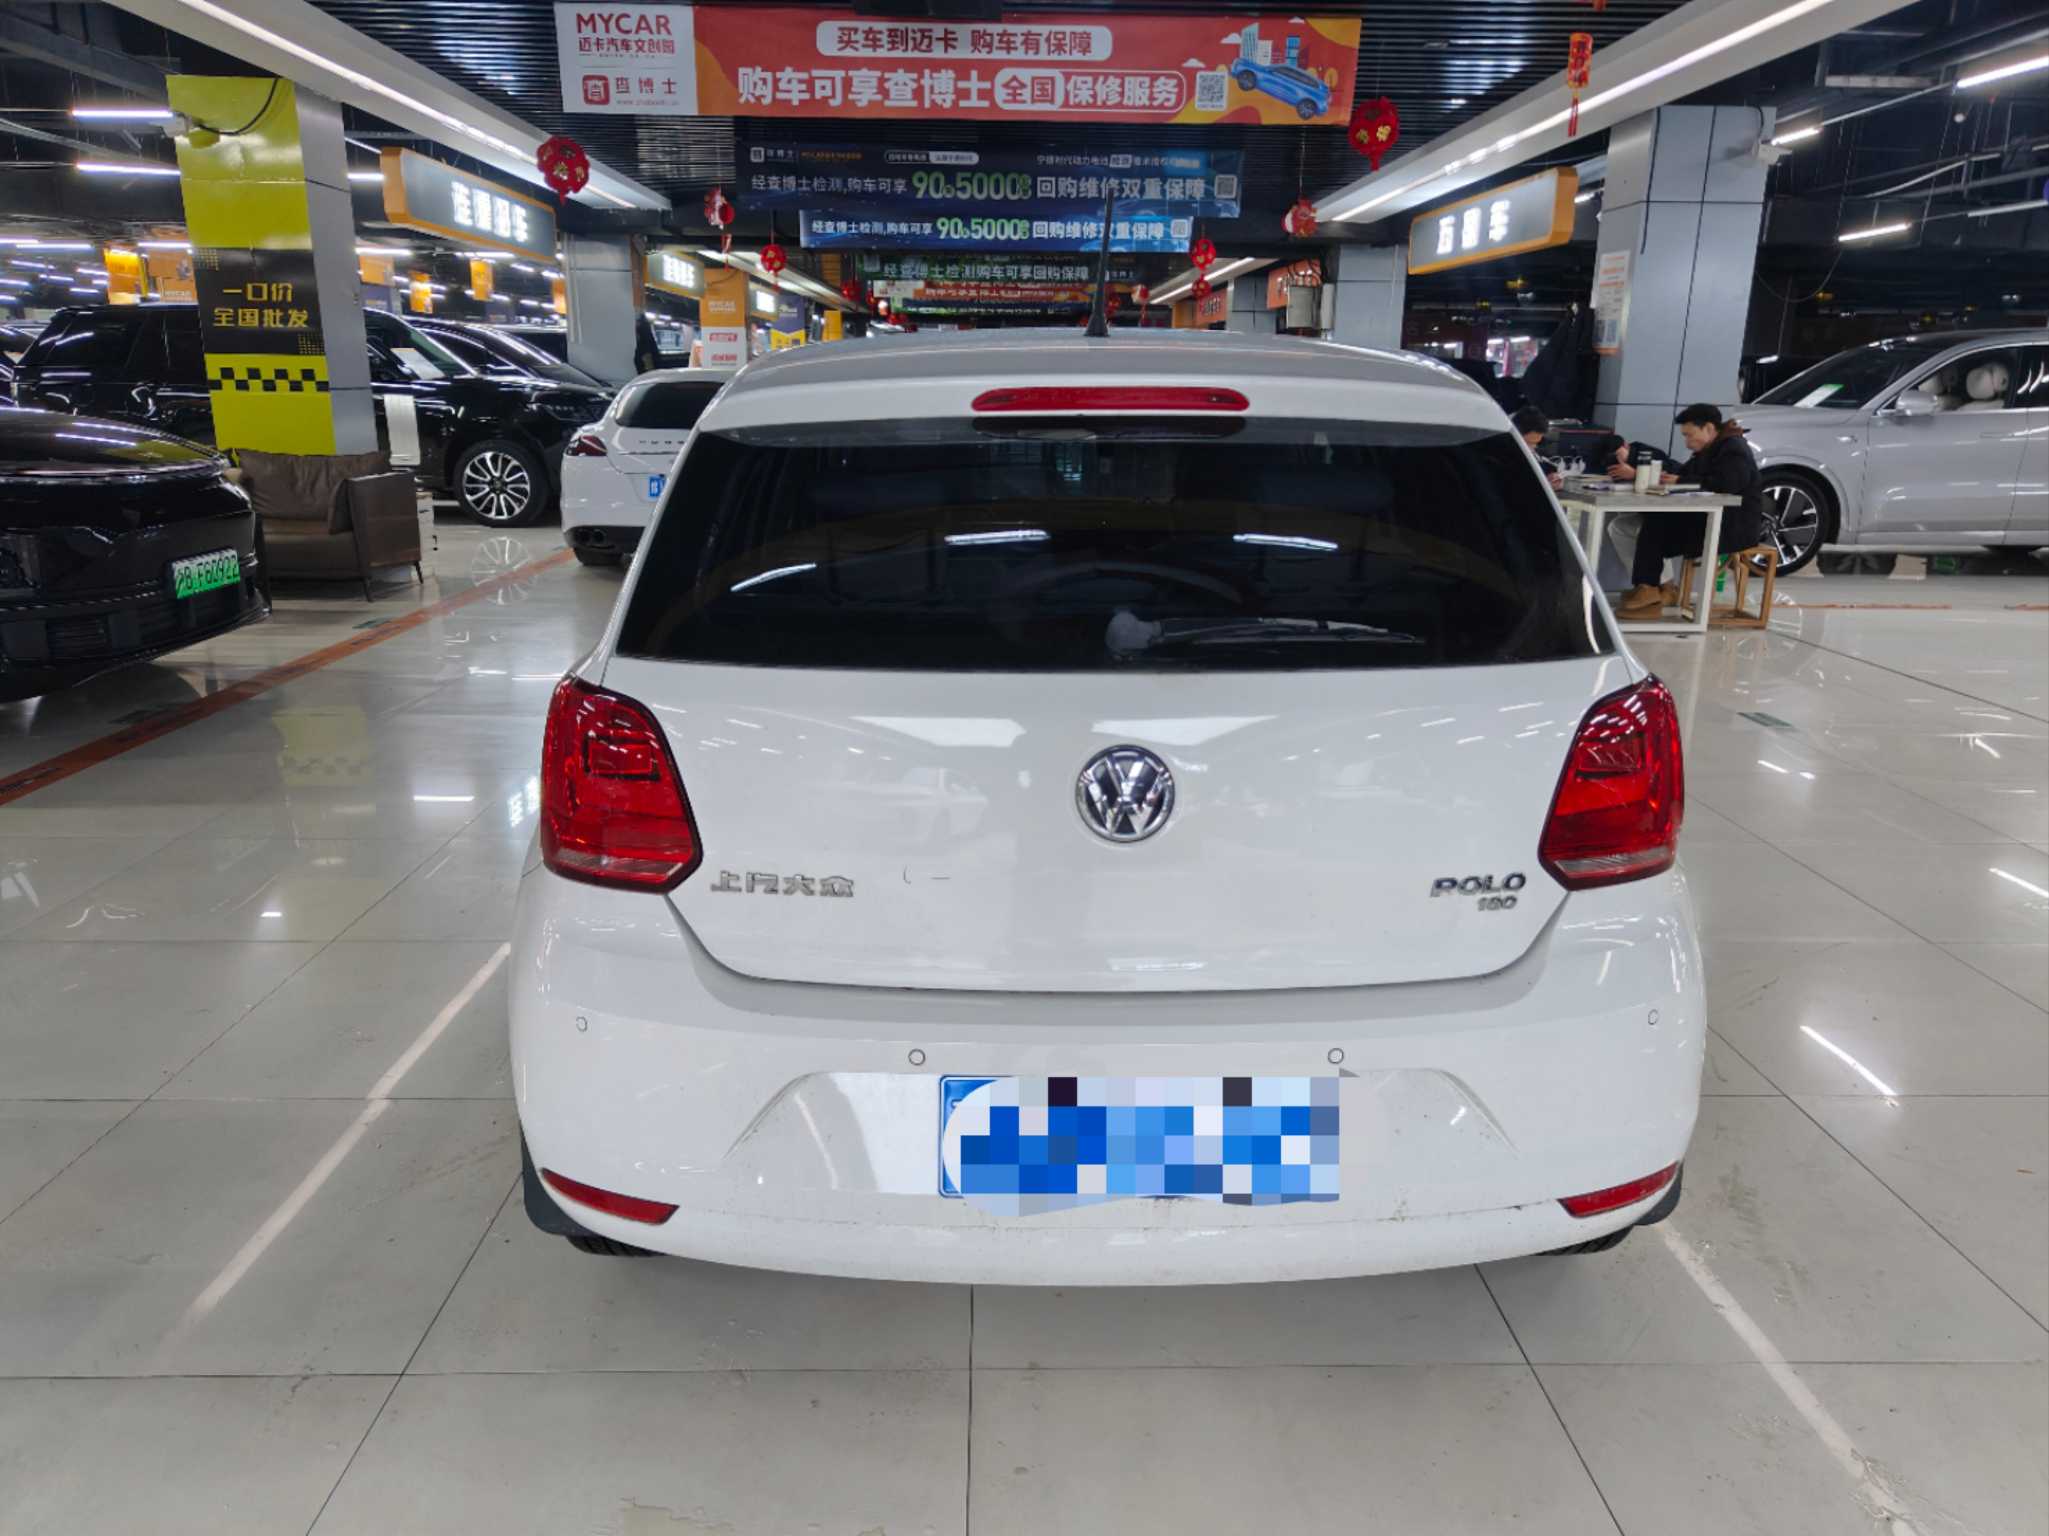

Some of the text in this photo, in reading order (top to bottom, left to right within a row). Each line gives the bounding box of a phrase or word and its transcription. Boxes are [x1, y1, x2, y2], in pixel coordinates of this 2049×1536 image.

[576, 12, 672, 36] MYCAR
[578, 37, 675, 54] 迈卡汽车文创园
[836, 26, 1092, 56] 买车到迈卡 购车有保障
[615, 77, 678, 94] 查博士
[737, 66, 1179, 109] 购车可享查博士 全国 保修服务
[222, 281, 294, 303] 一口价
[212, 307, 310, 330] 全国批发
[1430, 872, 1527, 898] POLO
